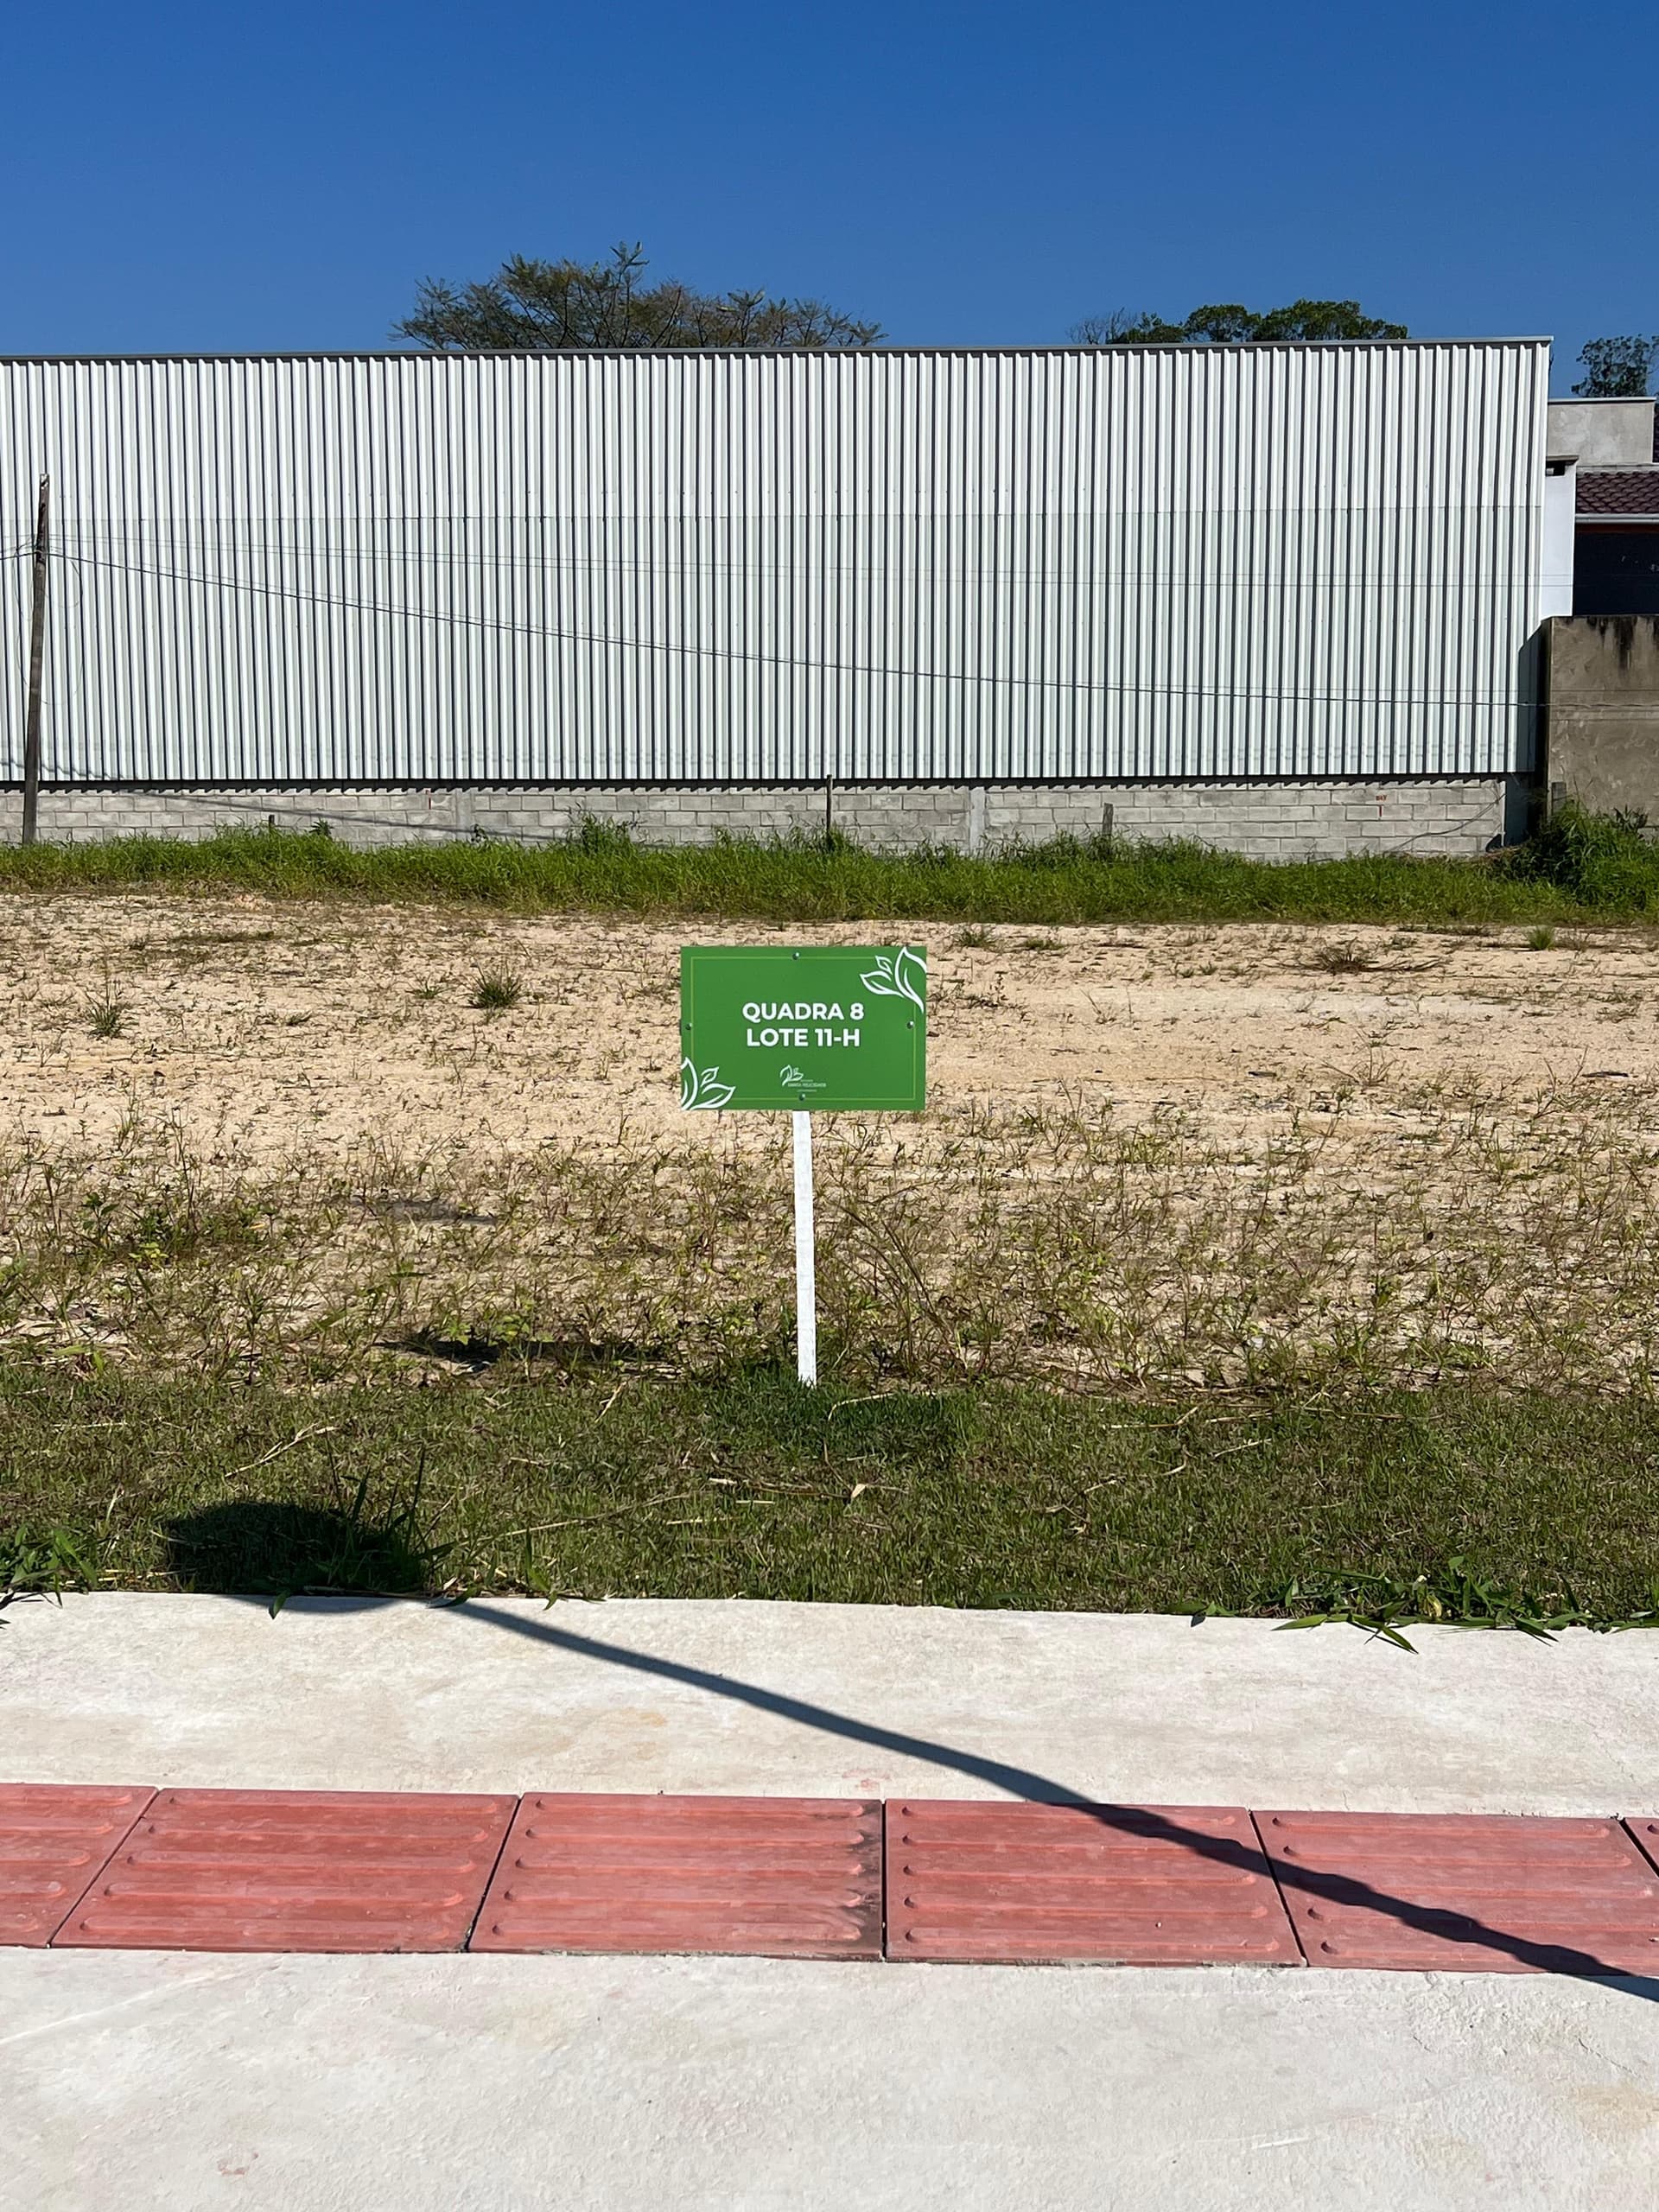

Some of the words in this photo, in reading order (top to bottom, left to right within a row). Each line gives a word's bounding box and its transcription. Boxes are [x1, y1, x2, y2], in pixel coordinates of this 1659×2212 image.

[742, 1002, 844, 1023] QUADRA
[849, 1002, 865, 1020] 8
[747, 1028, 809, 1046] LOTE
[815, 1028, 860, 1046] 11-H
